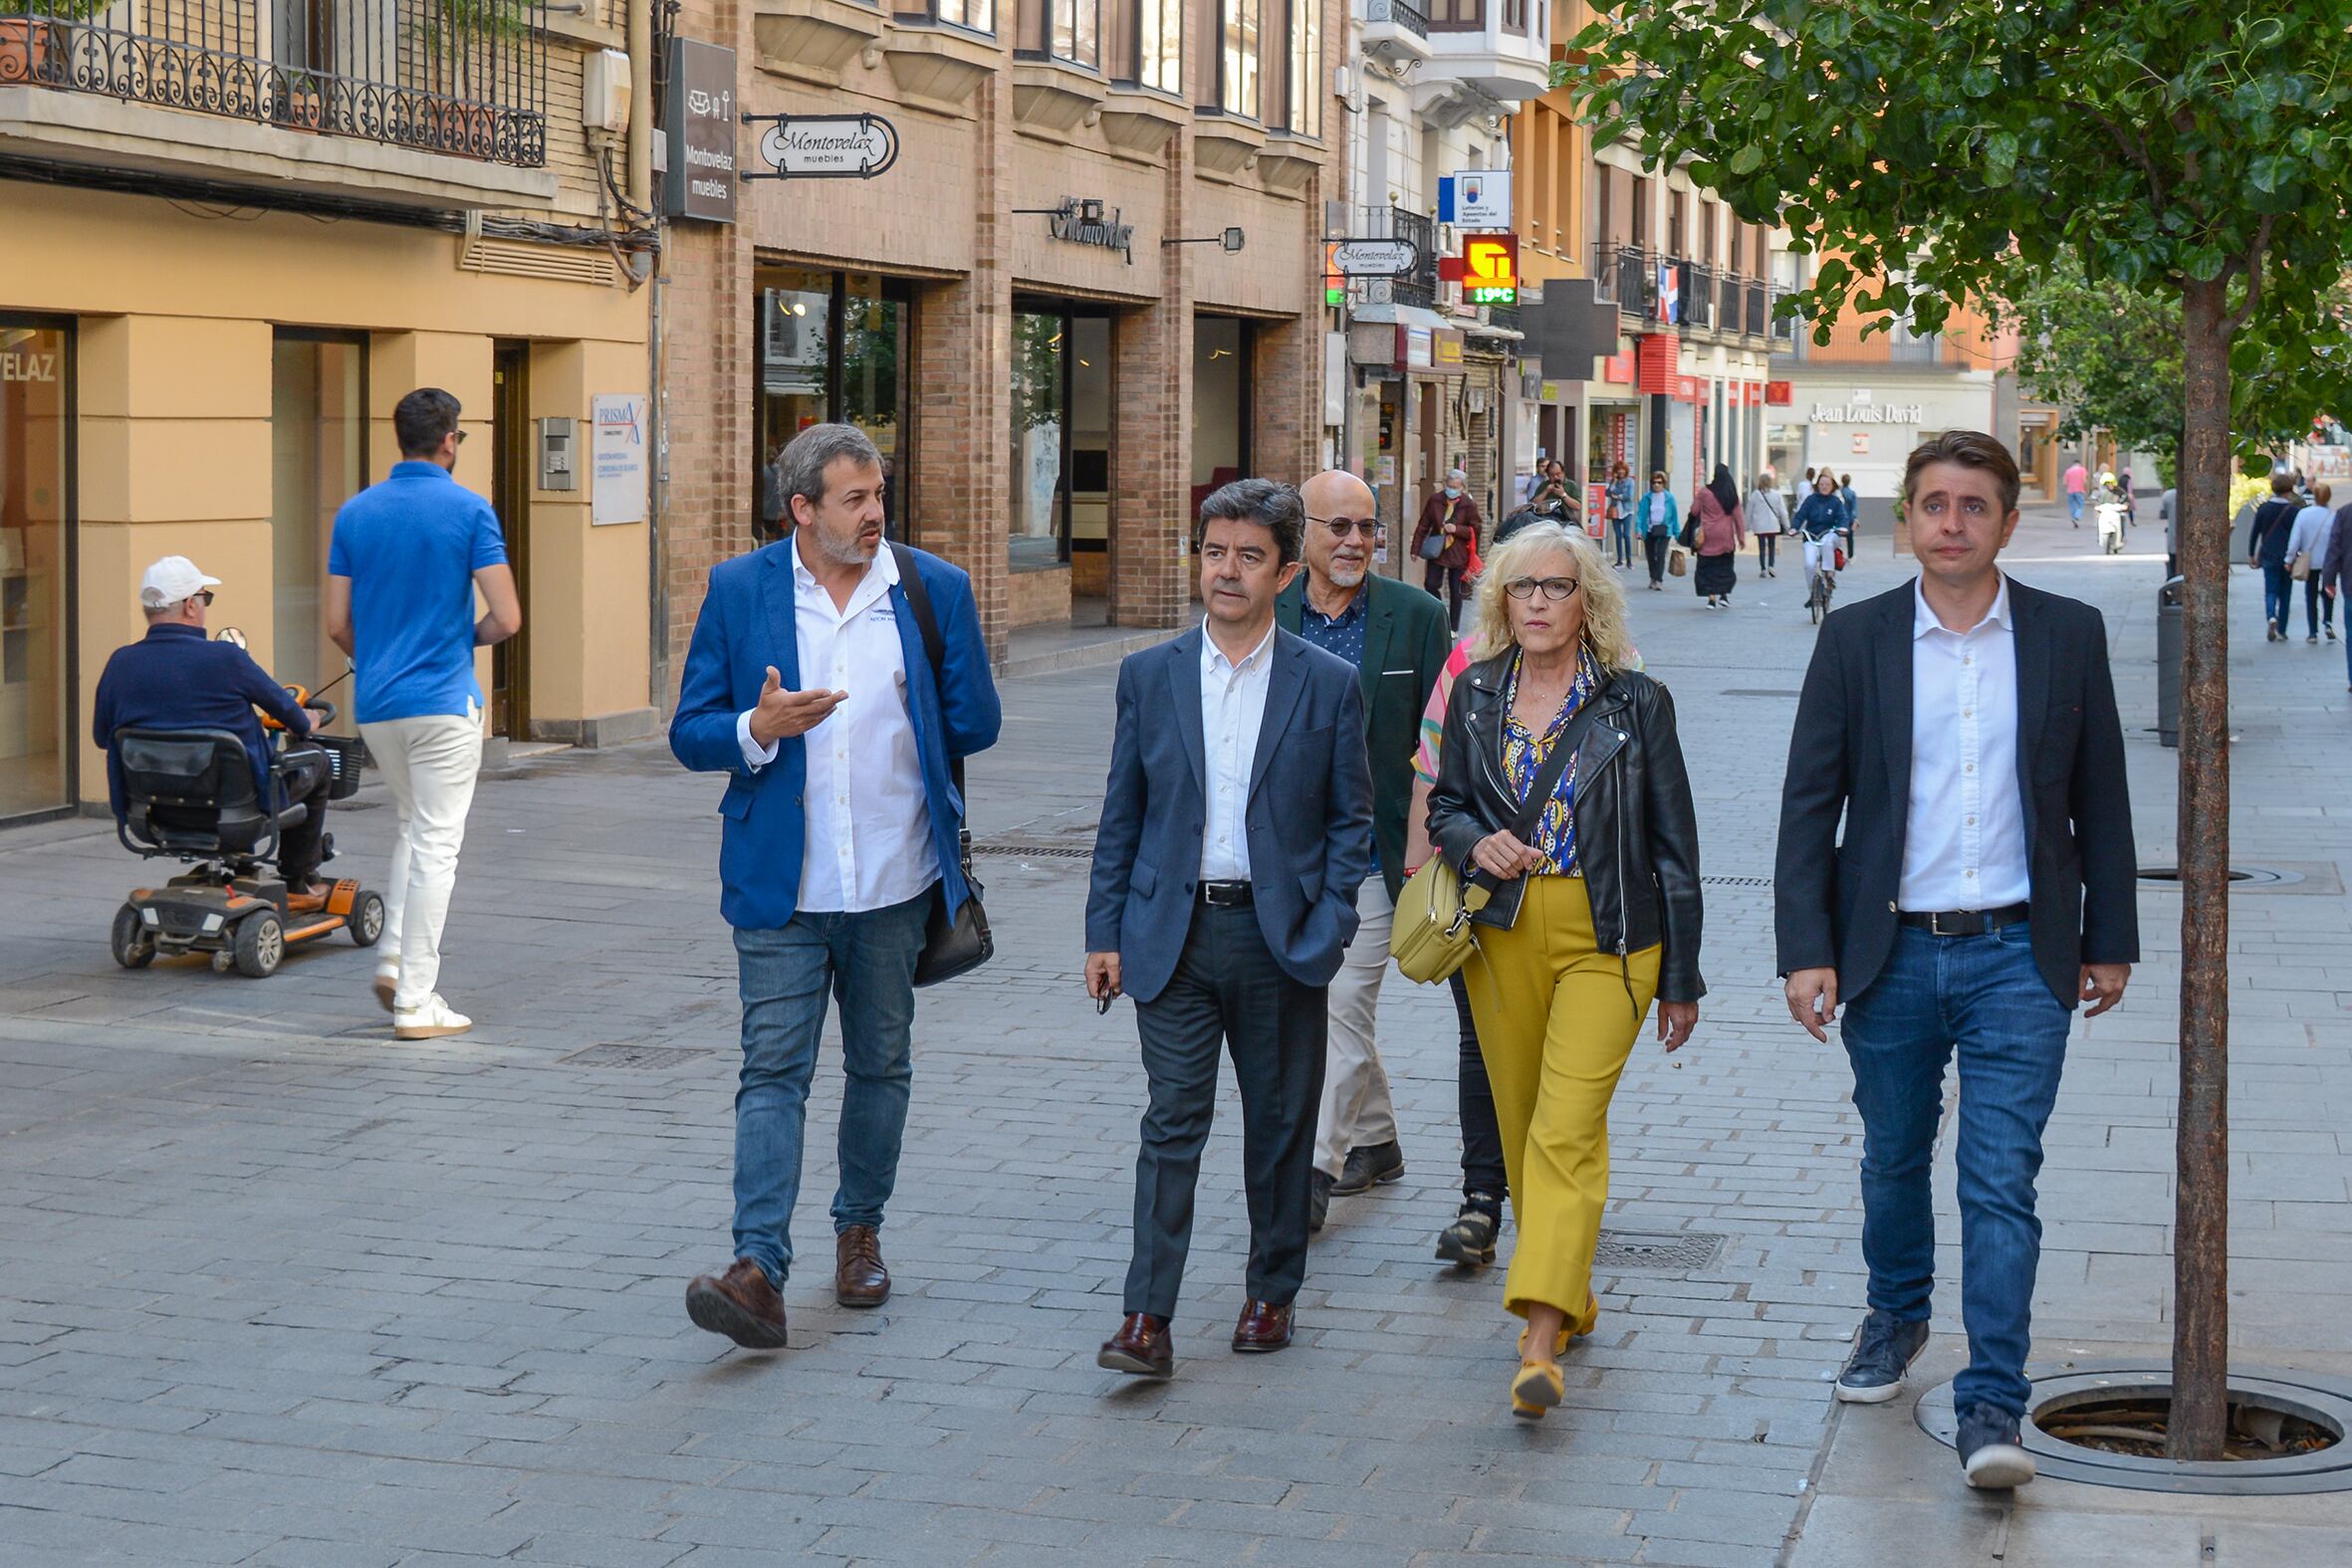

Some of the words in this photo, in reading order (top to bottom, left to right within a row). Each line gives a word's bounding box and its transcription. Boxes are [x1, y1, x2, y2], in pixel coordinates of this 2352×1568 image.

[774, 131, 875, 157] Montovelaz
[686, 144, 733, 171] Montovelaz
[804, 154, 844, 163] muebles
[692, 179, 727, 200] muebles
[1339, 248, 1405, 265] Montovelaz
[0, 351, 56, 381] ELAZ
[1810, 402, 1843, 423] Jean
[1845, 402, 1881, 423] Louis
[1884, 403, 1922, 423] David
